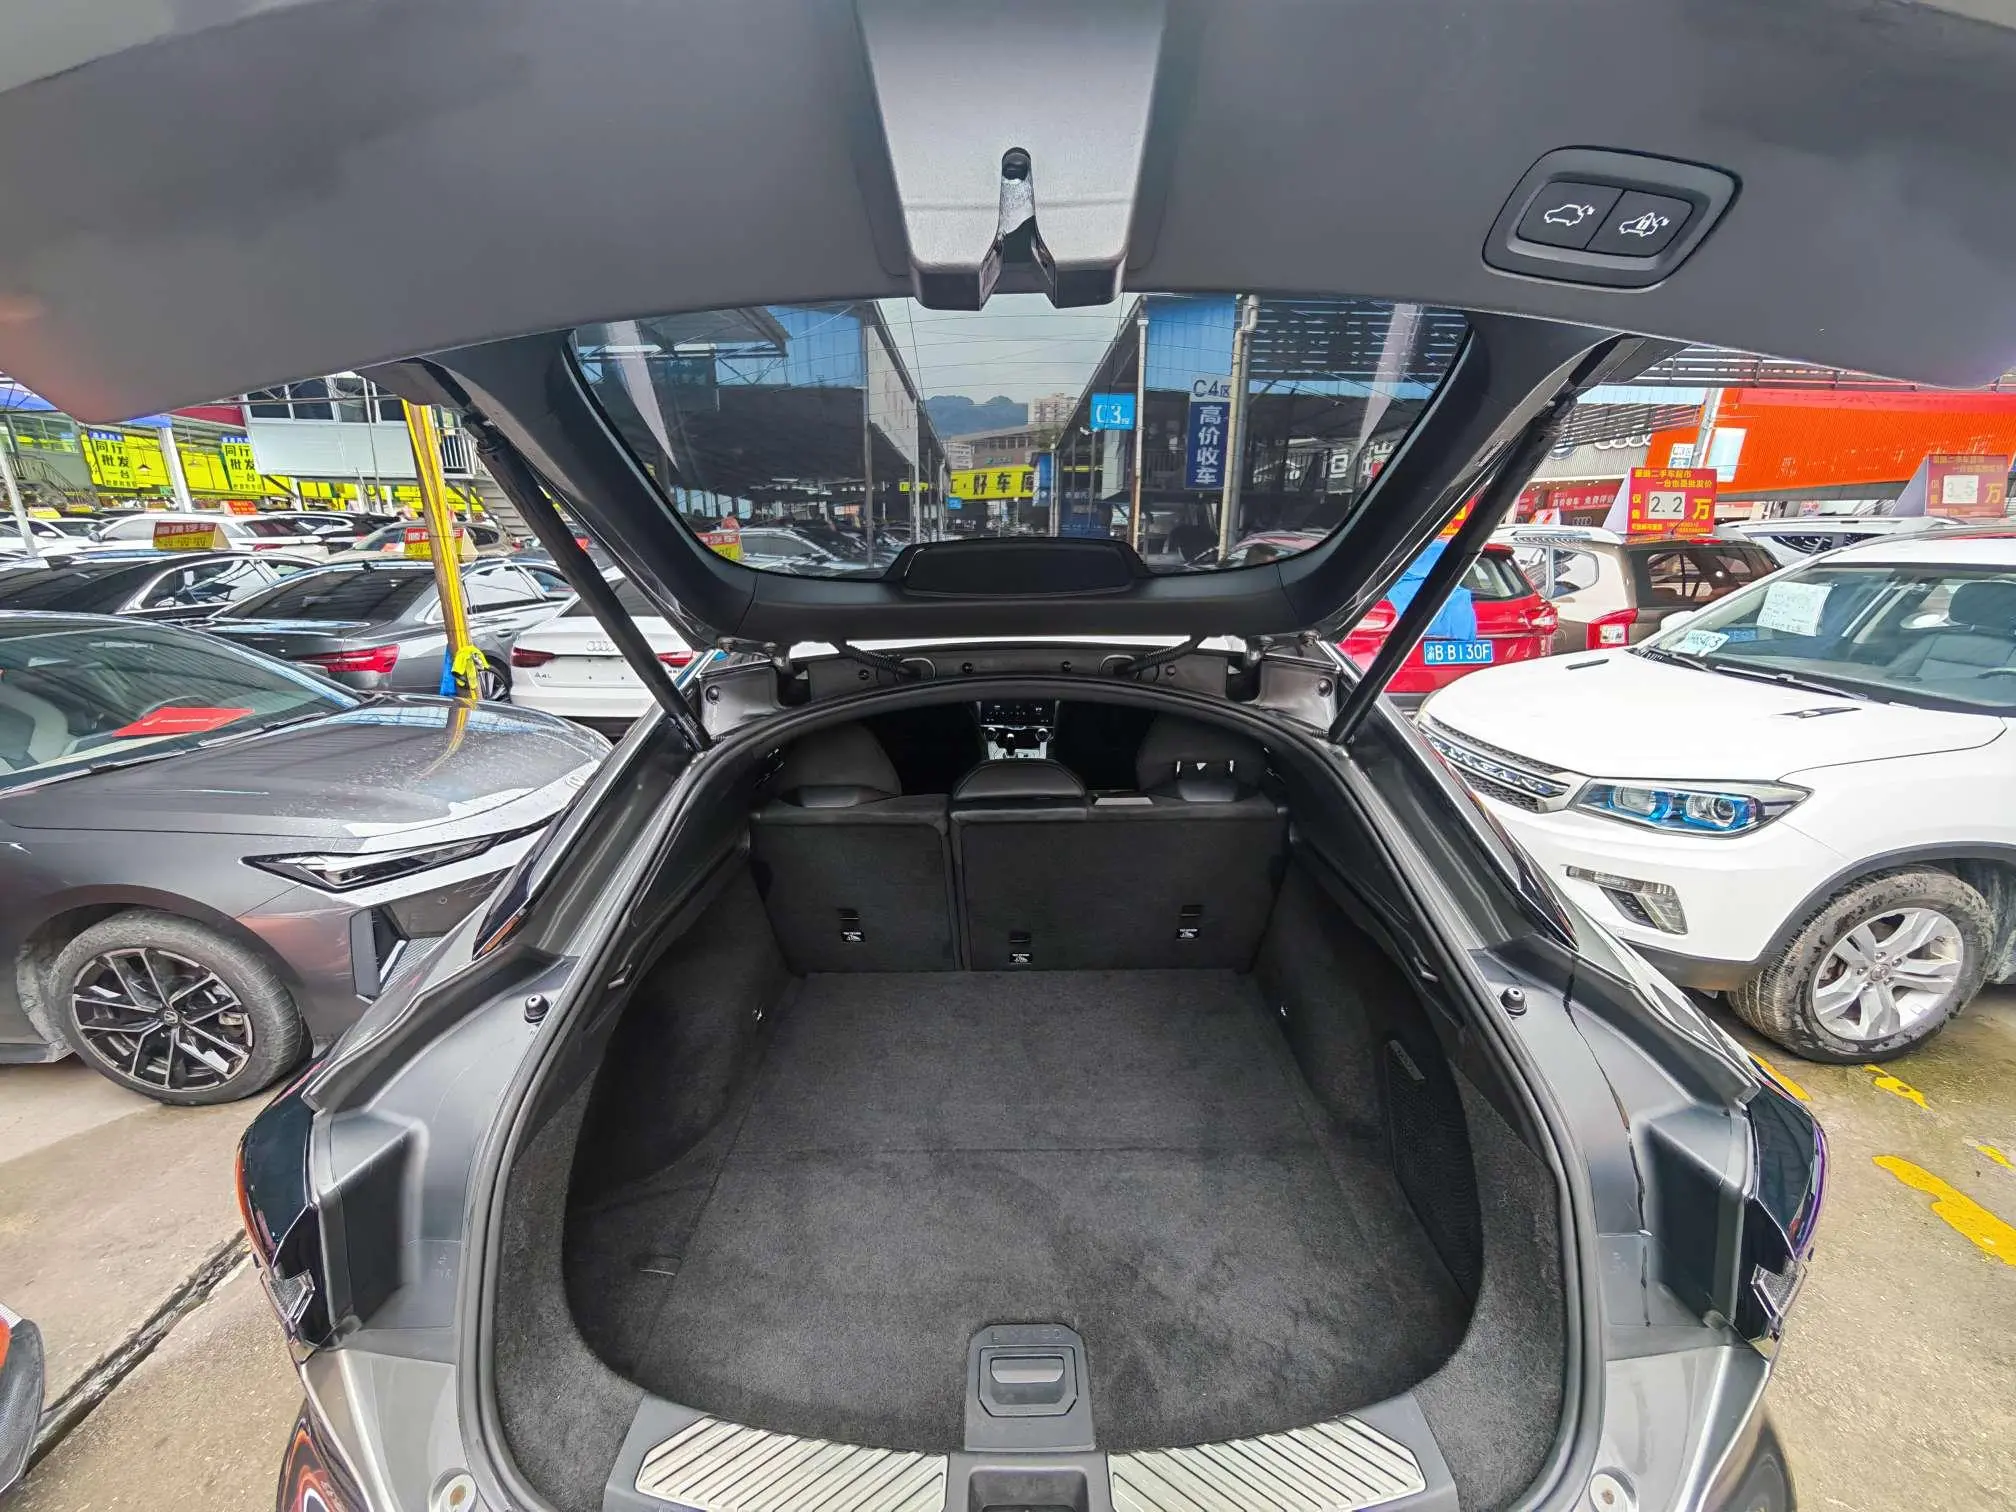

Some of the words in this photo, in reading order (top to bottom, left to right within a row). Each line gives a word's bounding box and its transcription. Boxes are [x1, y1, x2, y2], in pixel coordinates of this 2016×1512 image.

[1194, 405, 1222, 484] 高价收车
[1650, 496, 1683, 513] 2.2
[1692, 498, 1713, 520] 万
